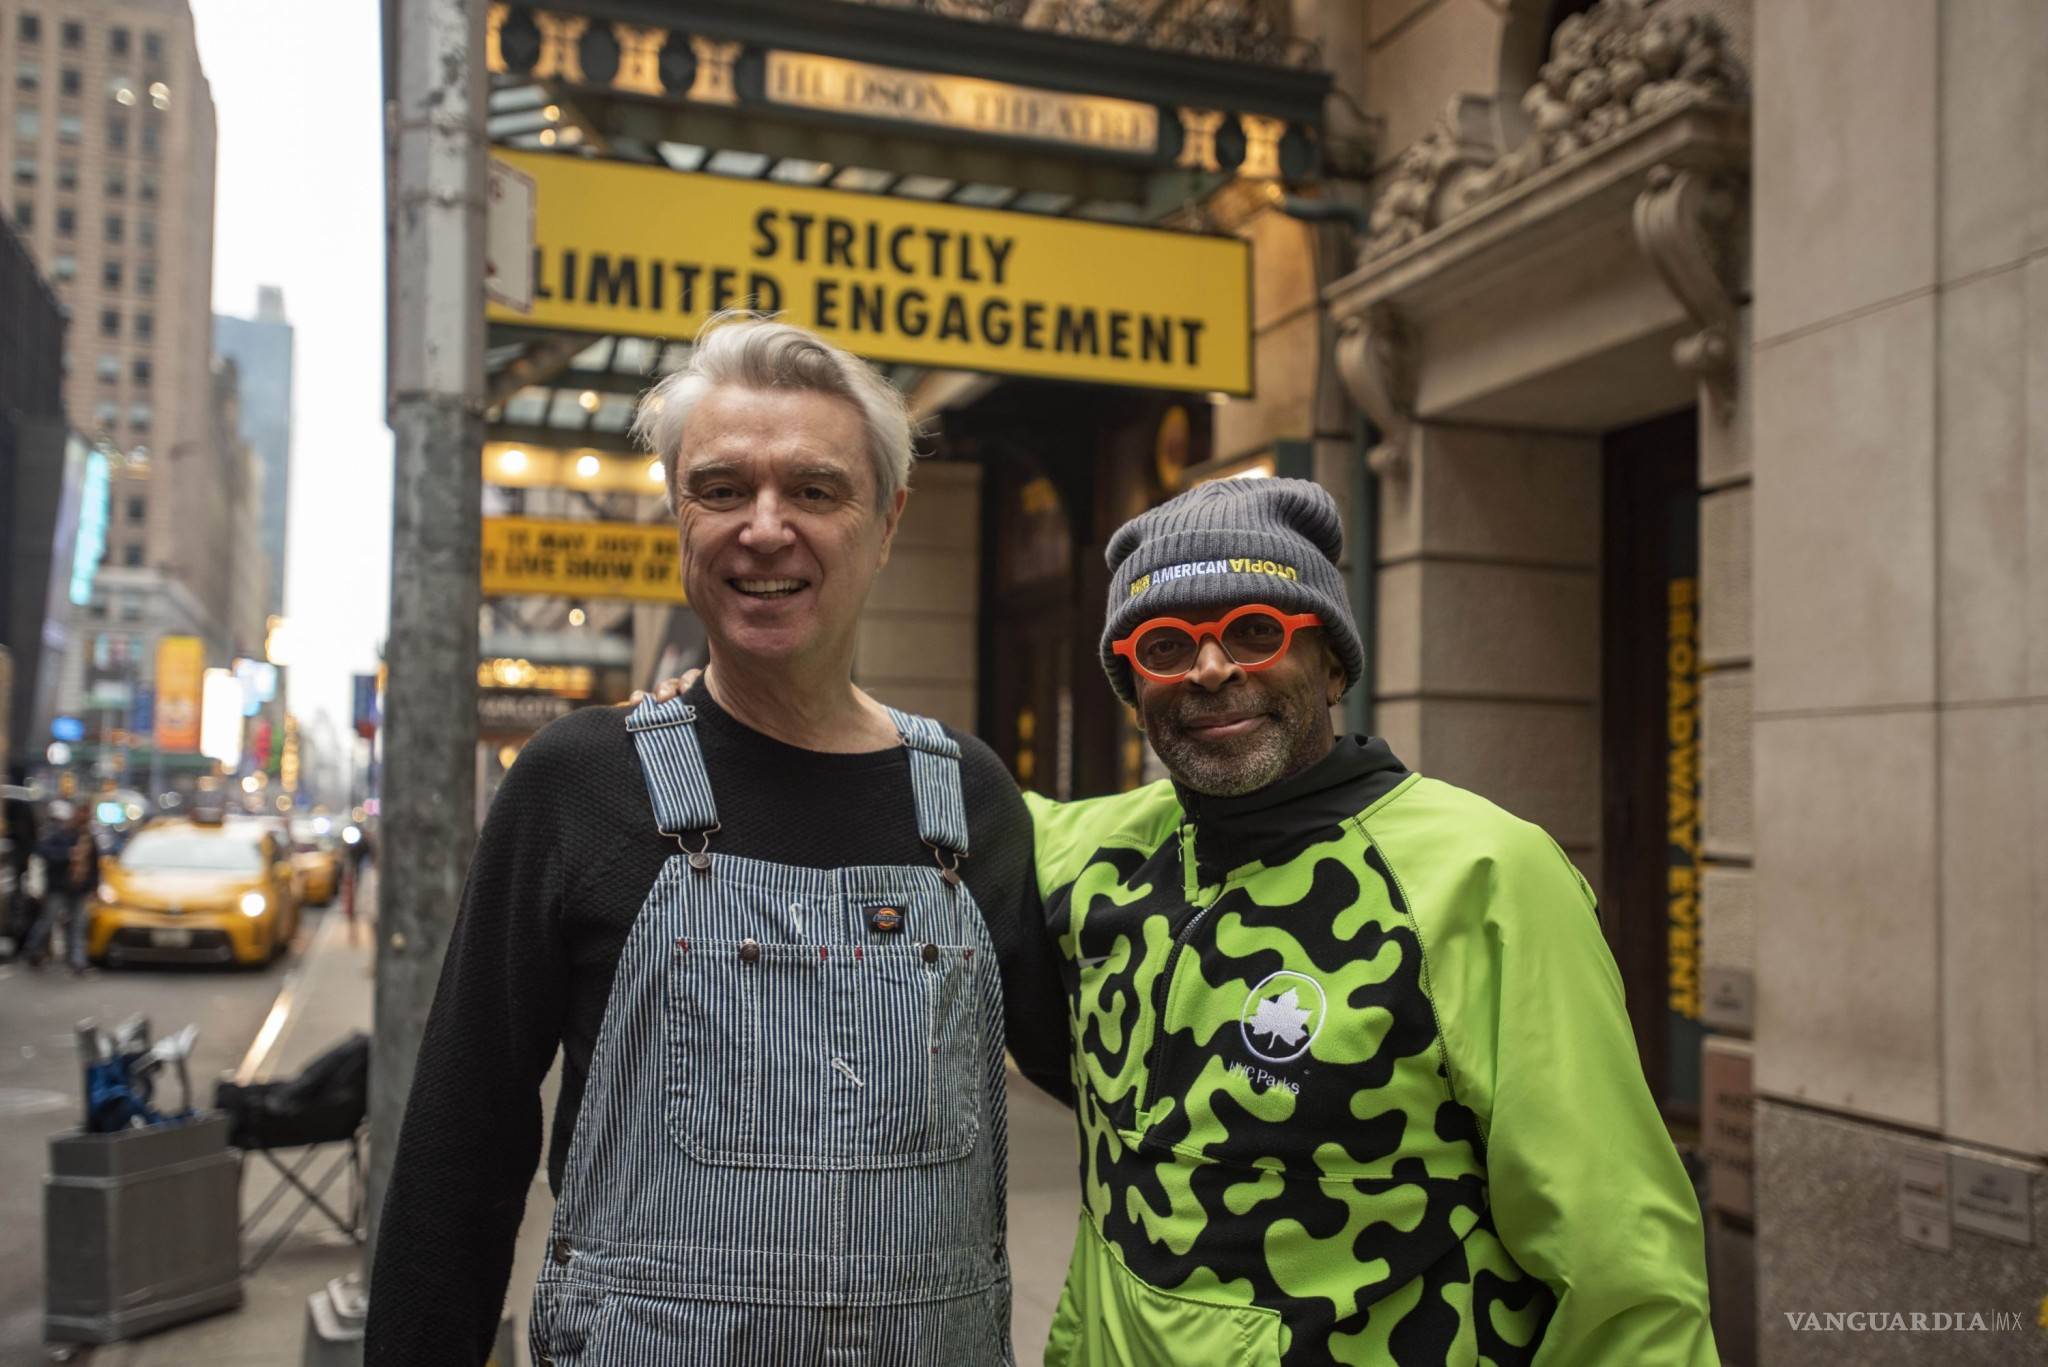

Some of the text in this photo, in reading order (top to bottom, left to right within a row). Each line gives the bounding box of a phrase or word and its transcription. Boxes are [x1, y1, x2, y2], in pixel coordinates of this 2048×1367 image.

[752, 207, 1016, 285] STRICTLY
[532, 247, 1206, 368] LIMITED ENGAGEMENT
[1152, 559, 1227, 586] AMERICAN
[1229, 558, 1297, 581] UTOPIA
[1667, 577, 1699, 852] BROADWAY
[1256, 1068, 1300, 1095] Parks
